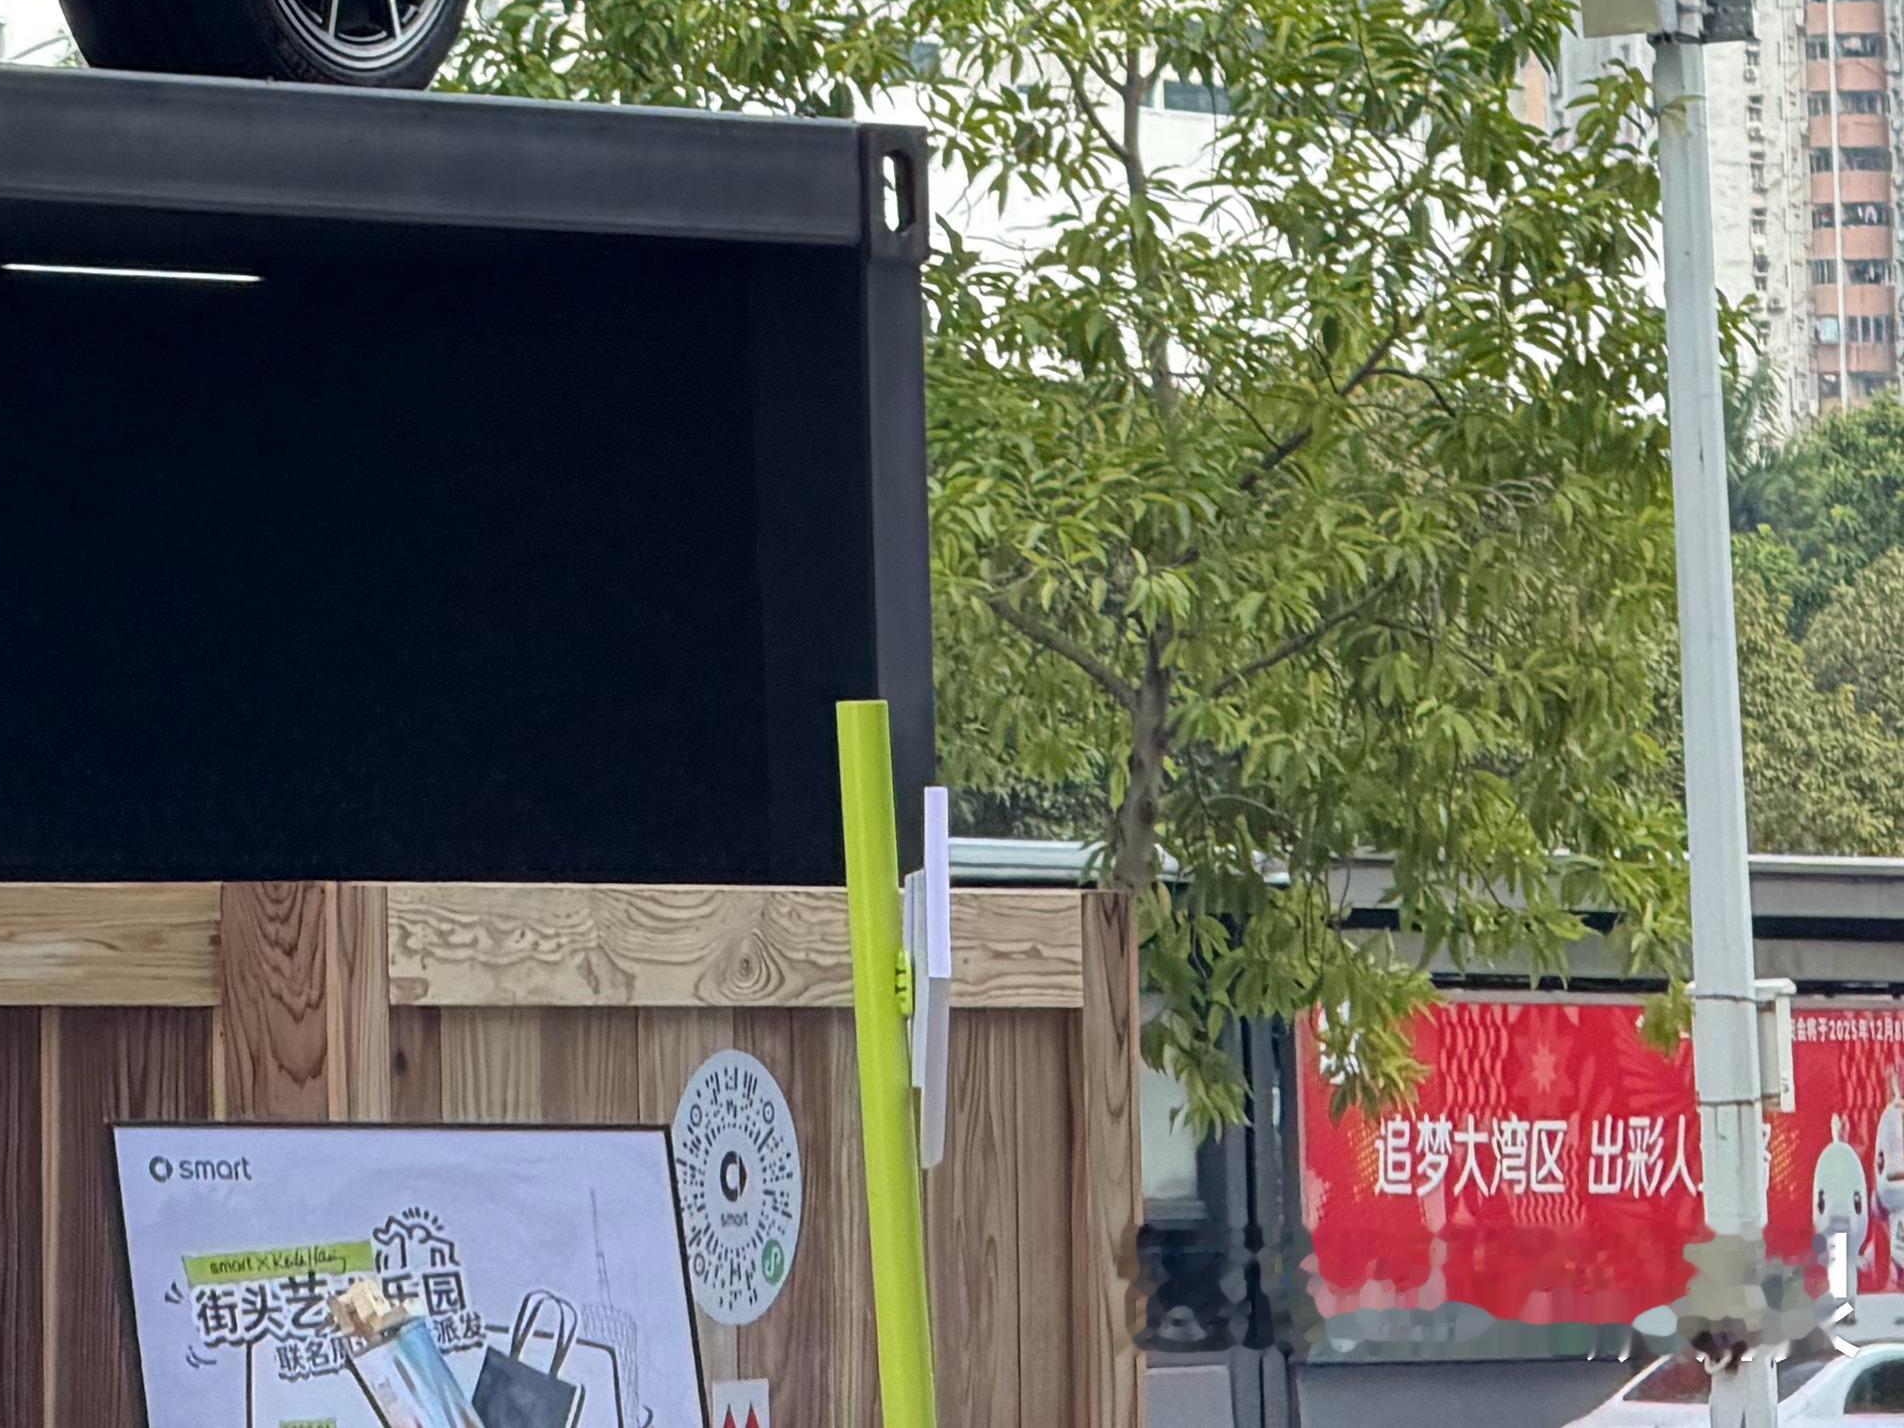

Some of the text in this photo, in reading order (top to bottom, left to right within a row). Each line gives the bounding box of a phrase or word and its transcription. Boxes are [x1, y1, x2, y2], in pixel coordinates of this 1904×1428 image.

[179, 1156, 253, 1181] smart
[1375, 1112, 1772, 1198] 追梦大湾区 出彩人
[195, 1270, 467, 1336] 街头艺乐园
